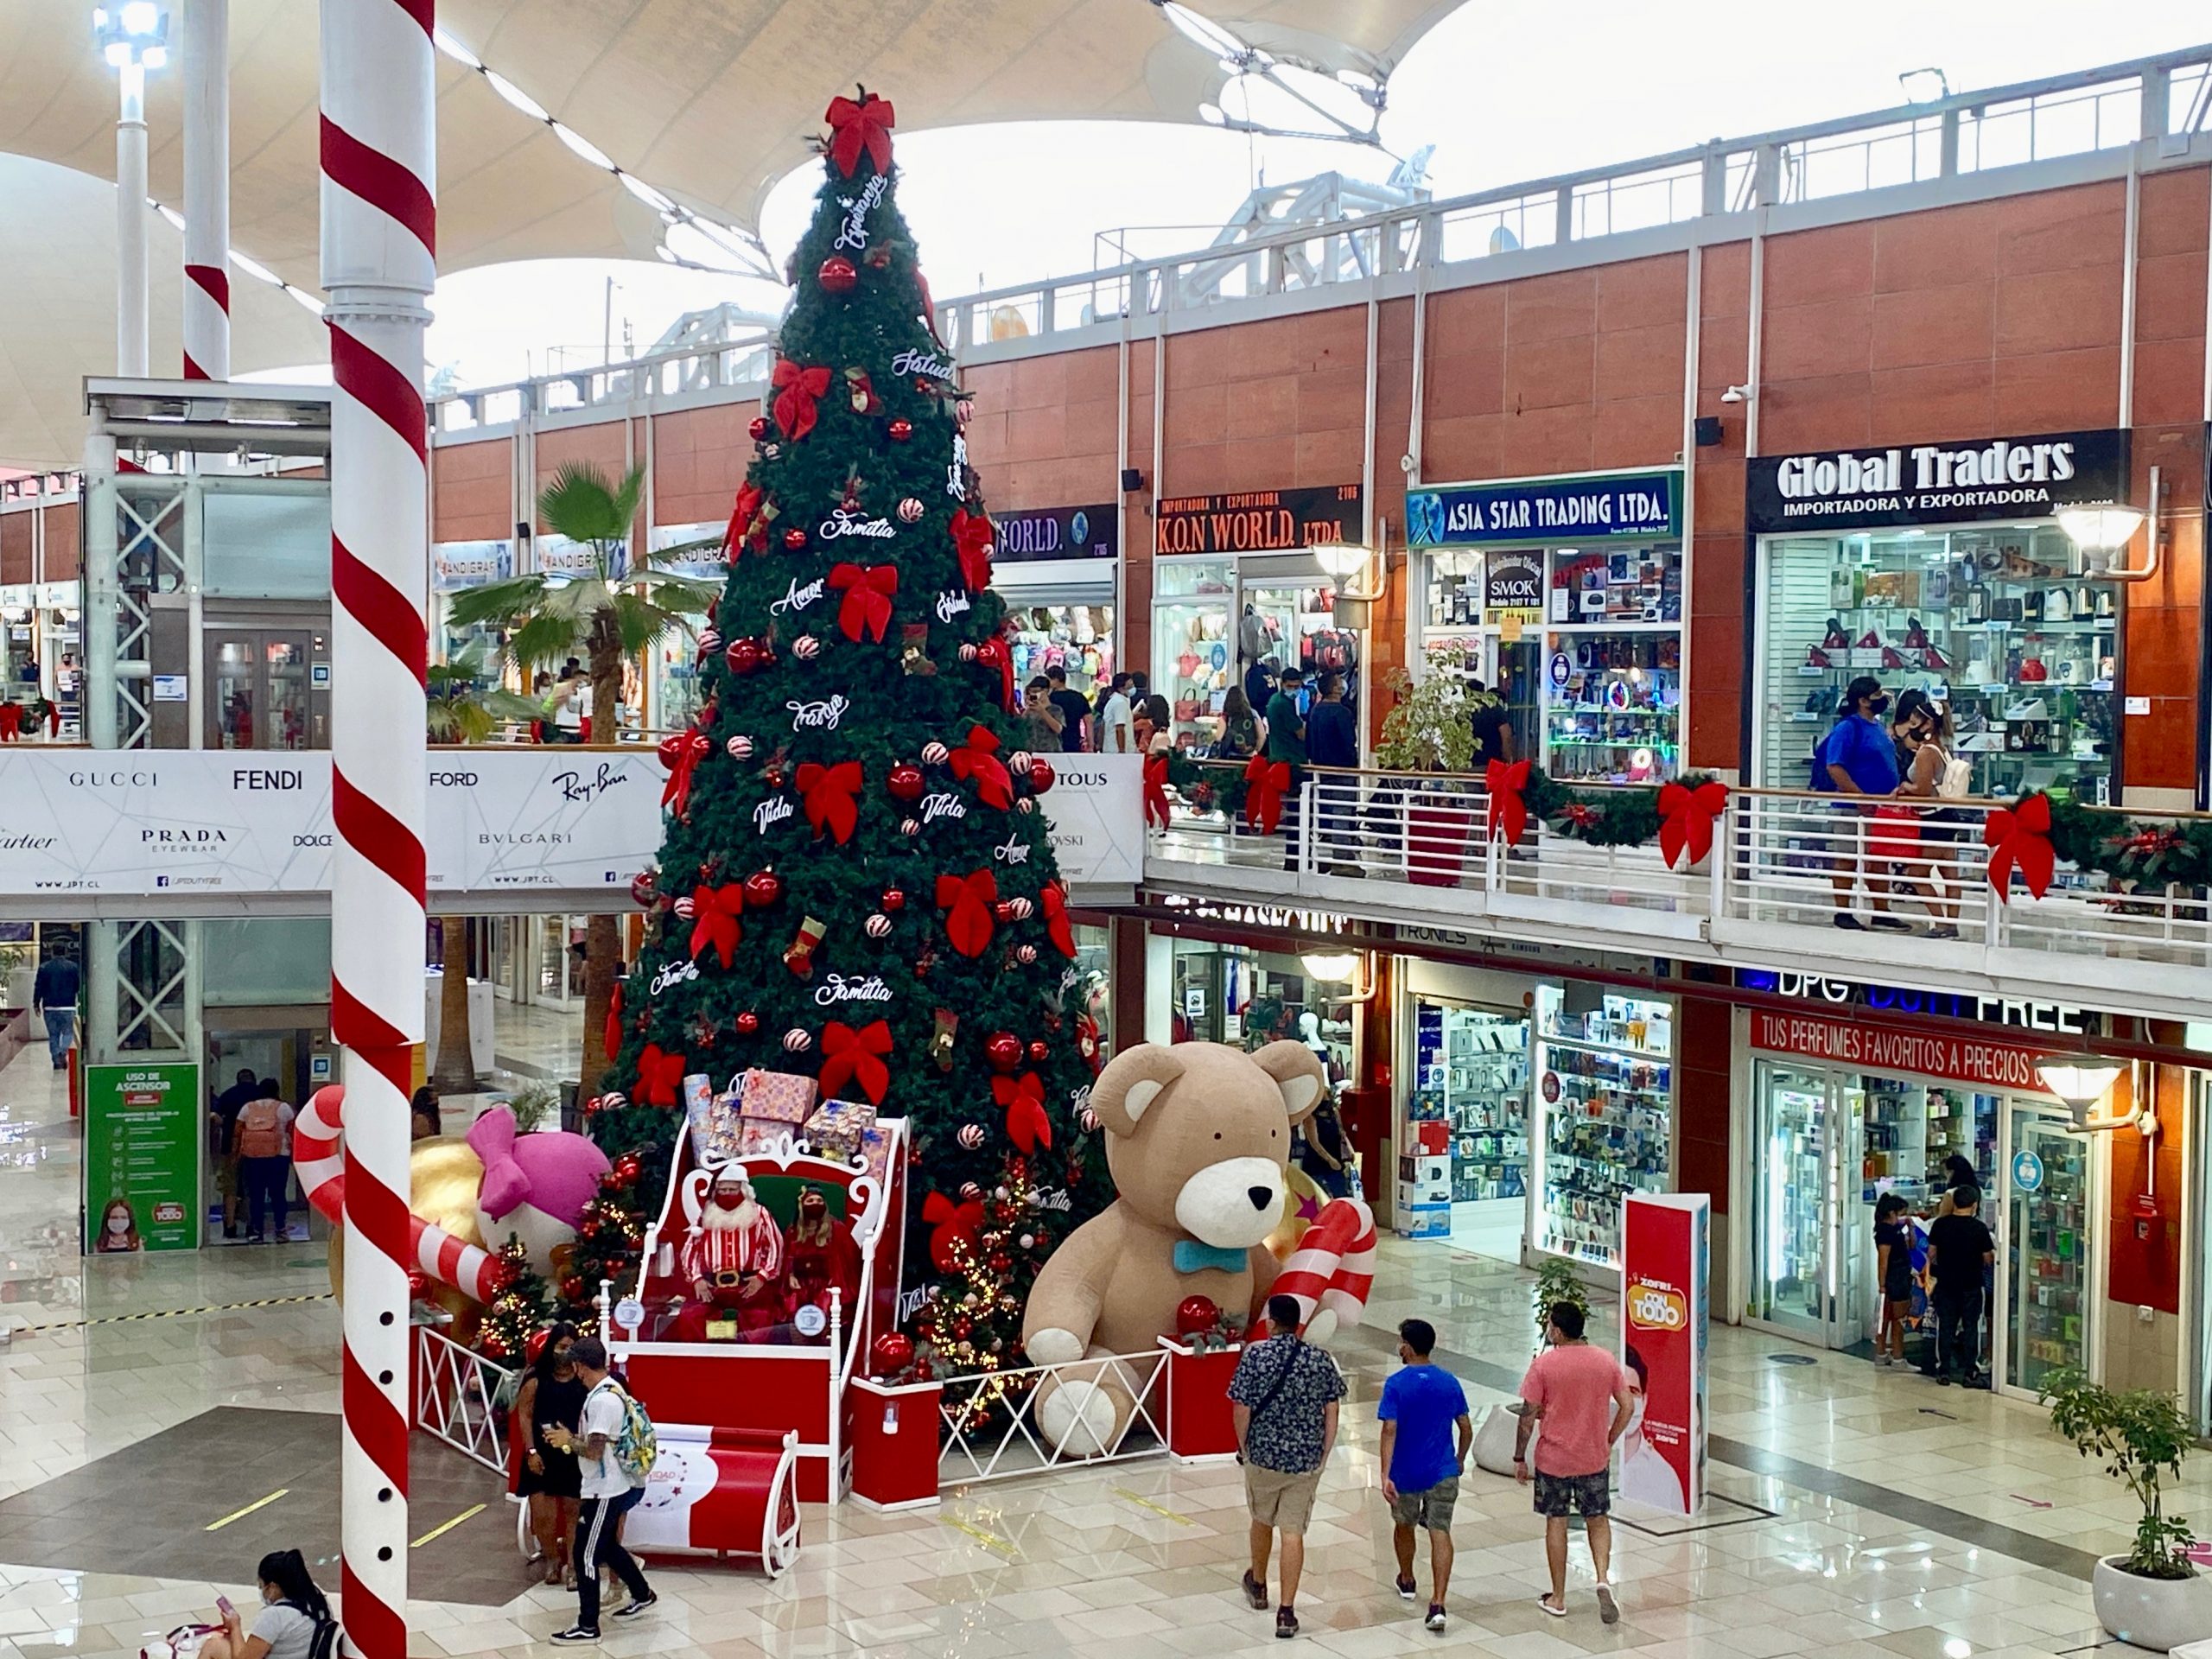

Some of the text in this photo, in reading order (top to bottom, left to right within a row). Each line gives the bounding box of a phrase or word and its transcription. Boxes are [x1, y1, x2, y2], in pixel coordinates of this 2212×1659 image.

[834, 174, 888, 250] Esperanza
[891, 348, 954, 381] Salud
[1777, 441, 2075, 499] Global Traders
[1161, 493, 1279, 513] IMPORTADORA Y EXPORTADORA
[1447, 491, 1669, 531] ASIA STAR TRADING LTDA.
[1783, 496, 1899, 516] IMPORTADORA
[1905, 495, 1916, 510] Y
[1920, 487, 2049, 509] EXPORTADORA
[820, 509, 897, 539] Familia
[770, 577, 824, 616] Amor
[1491, 580, 1536, 596] SMOK
[70, 772, 157, 787] GUCCI
[233, 770, 302, 790] FENDI
[429, 772, 478, 787] FORD
[552, 763, 628, 802] Ray-Ban
[1058, 772, 1108, 786] TOUS
[753, 795, 794, 835] Vida
[920, 792, 968, 824] Vida
[142, 830, 227, 842] PRADA
[480, 833, 572, 844] BVLGARI
[35, 880, 101, 889] WWW.JPT.CL
[815, 973, 893, 1006] Familia
[1761, 1015, 1787, 1047] TUS
[1790, 1019, 1861, 1059] PERFUMES
[1865, 1031, 1945, 1073] FAVORITOS
[1948, 1042, 1961, 1075] A
[1964, 1044, 2029, 1085] PRECIOS
[115, 1081, 171, 1091] ASCENSOR
[126, 1072, 146, 1081] USO
[1640, 1277, 1672, 1291] ZOFRI
[1644, 1292, 1668, 1307] CON
[1634, 1299, 1680, 1325] TODO
